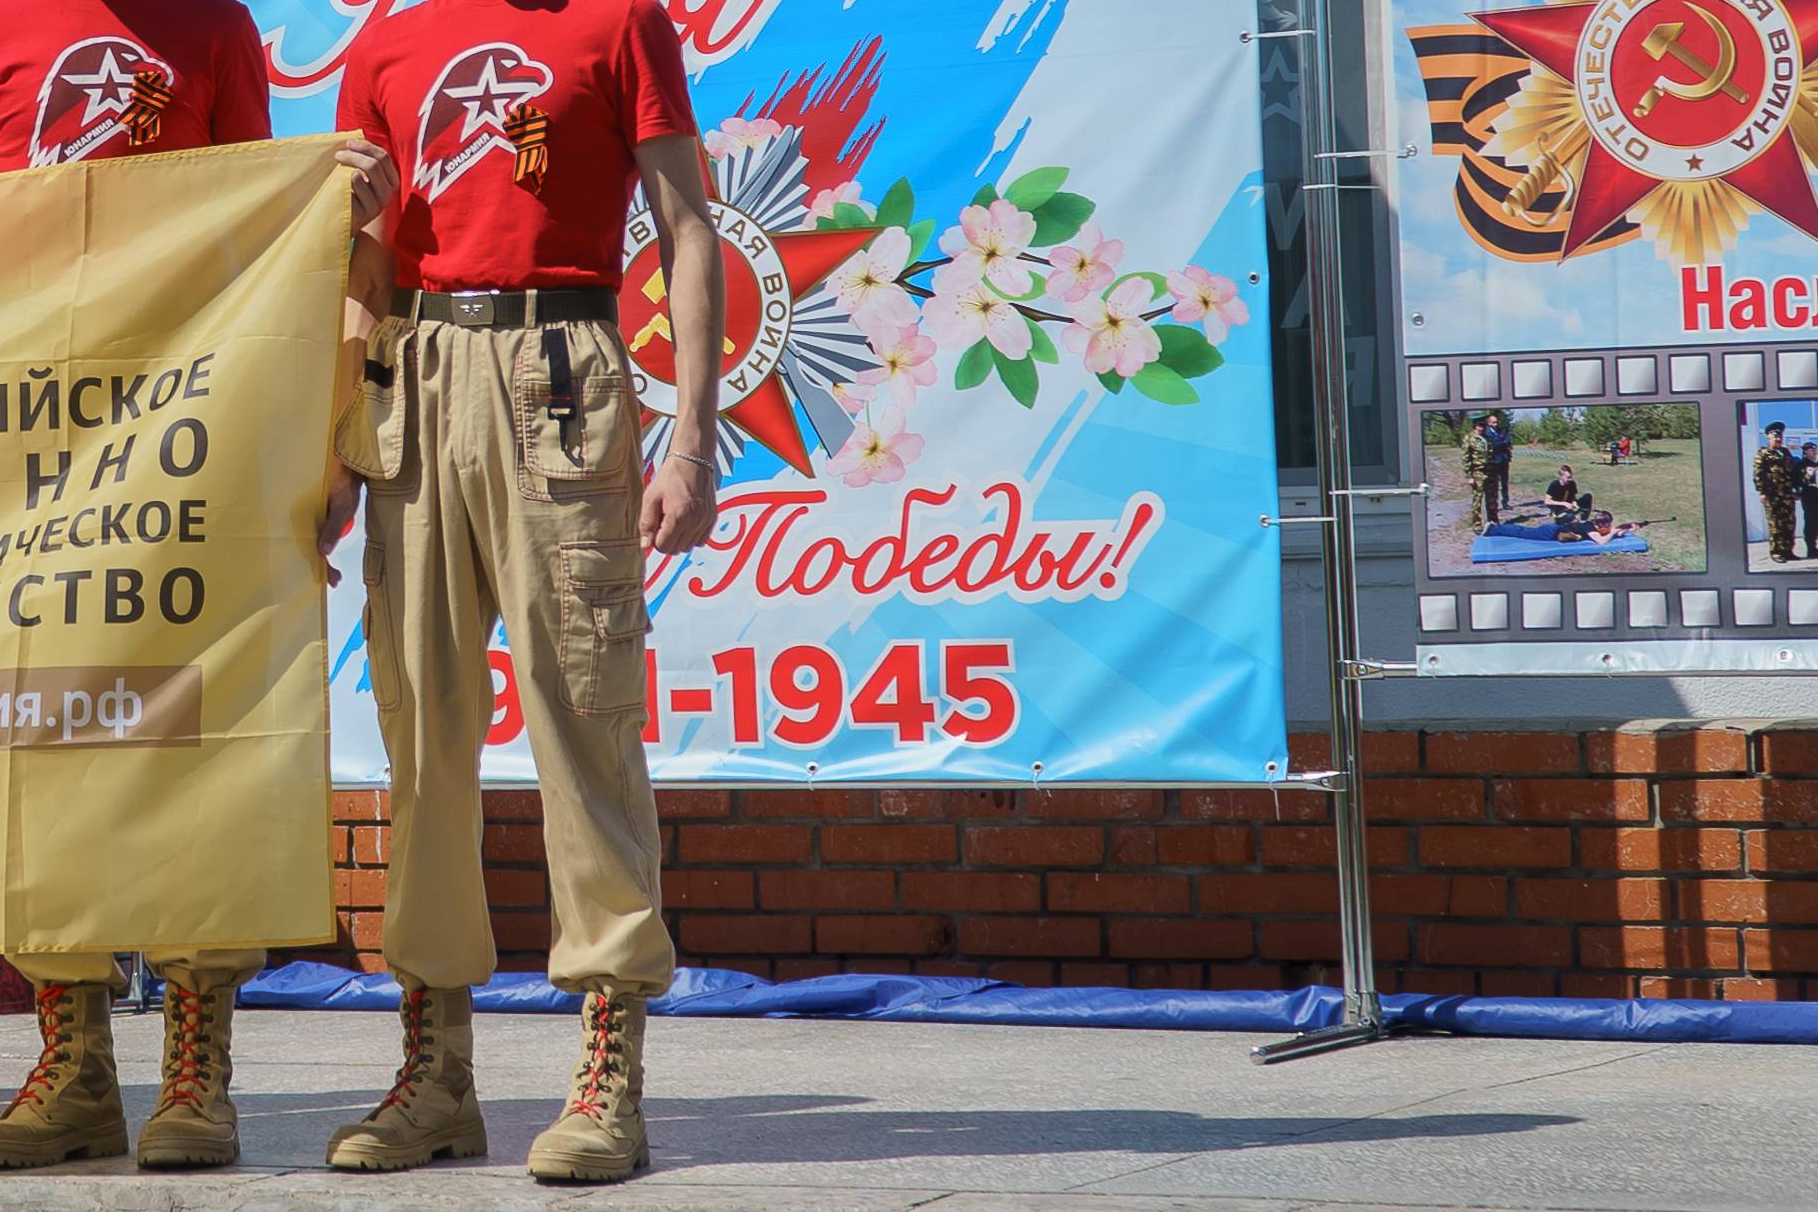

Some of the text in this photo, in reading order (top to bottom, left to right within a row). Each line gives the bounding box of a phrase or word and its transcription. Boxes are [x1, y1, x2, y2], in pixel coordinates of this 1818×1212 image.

[63, 118, 115, 157] ЮНАРМИЯ
[444, 132, 491, 173] ЮНАРМИЯ
[1682, 266, 1818, 331] Нас
[688, 482, 1153, 600] Победы!
